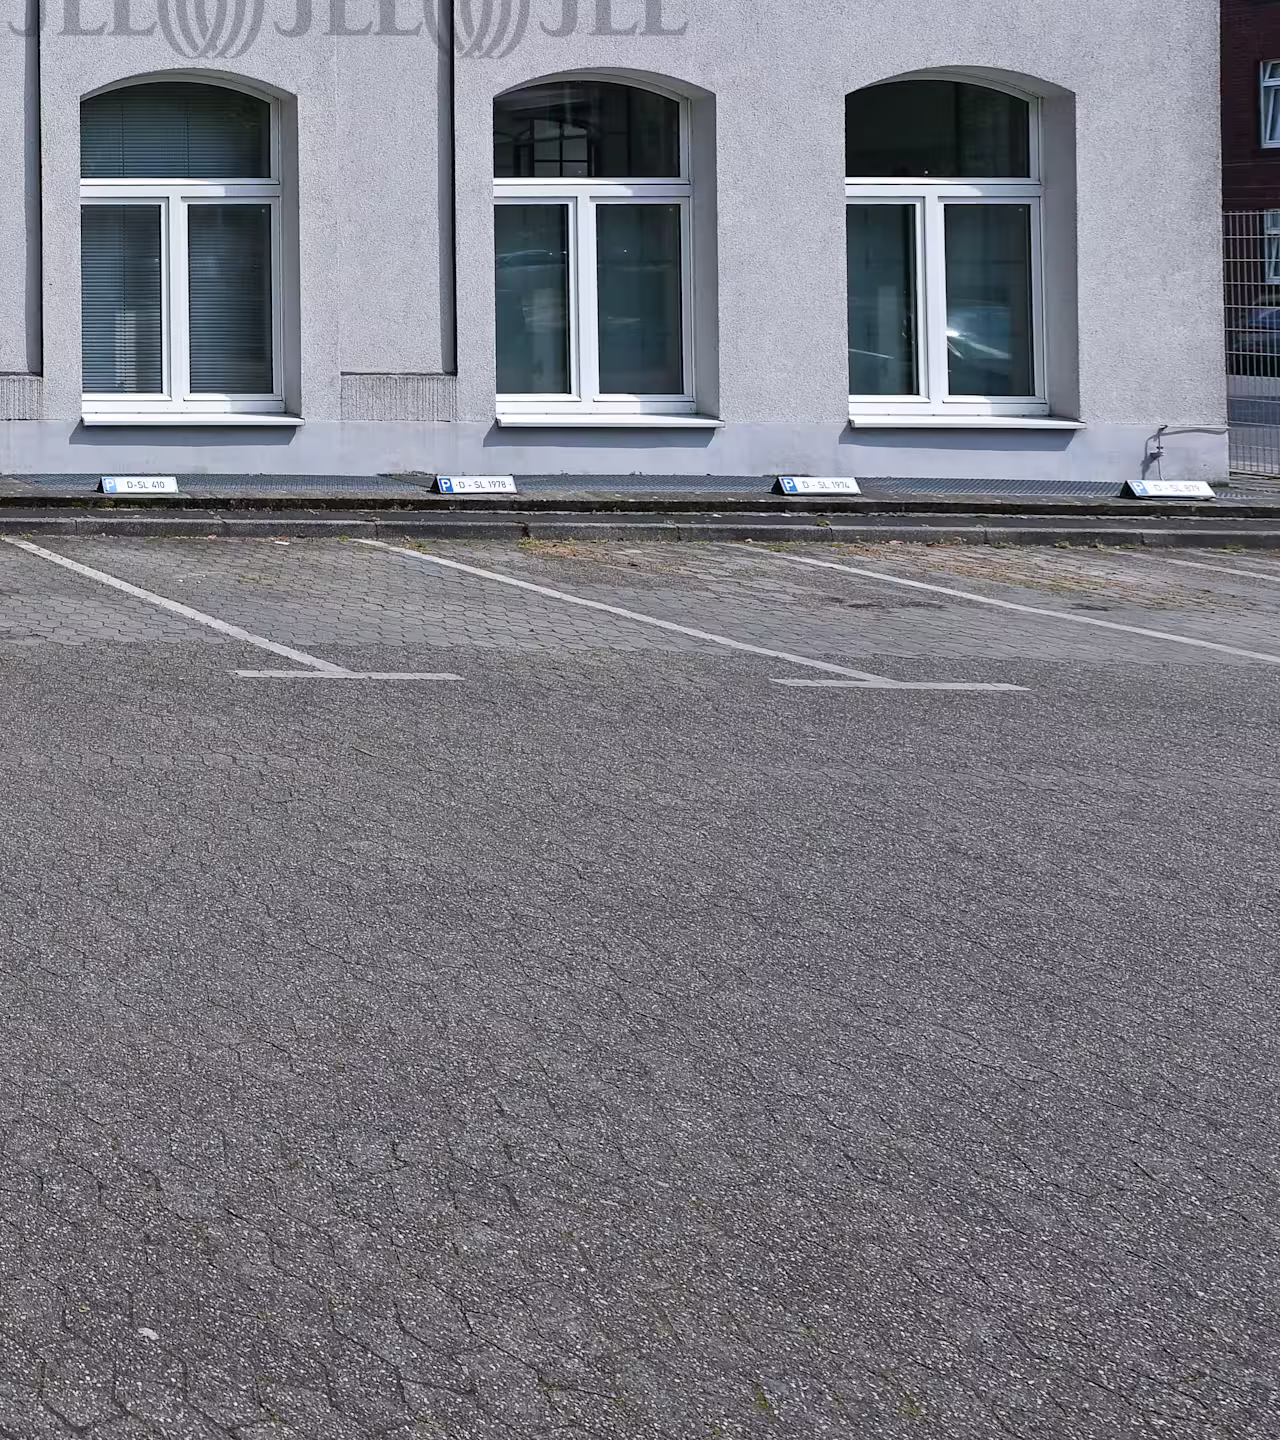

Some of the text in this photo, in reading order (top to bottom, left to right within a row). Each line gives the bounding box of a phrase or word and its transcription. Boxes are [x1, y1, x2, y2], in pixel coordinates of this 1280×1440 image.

[105, 479, 115, 491] P
[151, 481, 165, 489] 410
[441, 479, 451, 491] P
[488, 481, 507, 489] 1978
[783, 479, 794, 491] P
